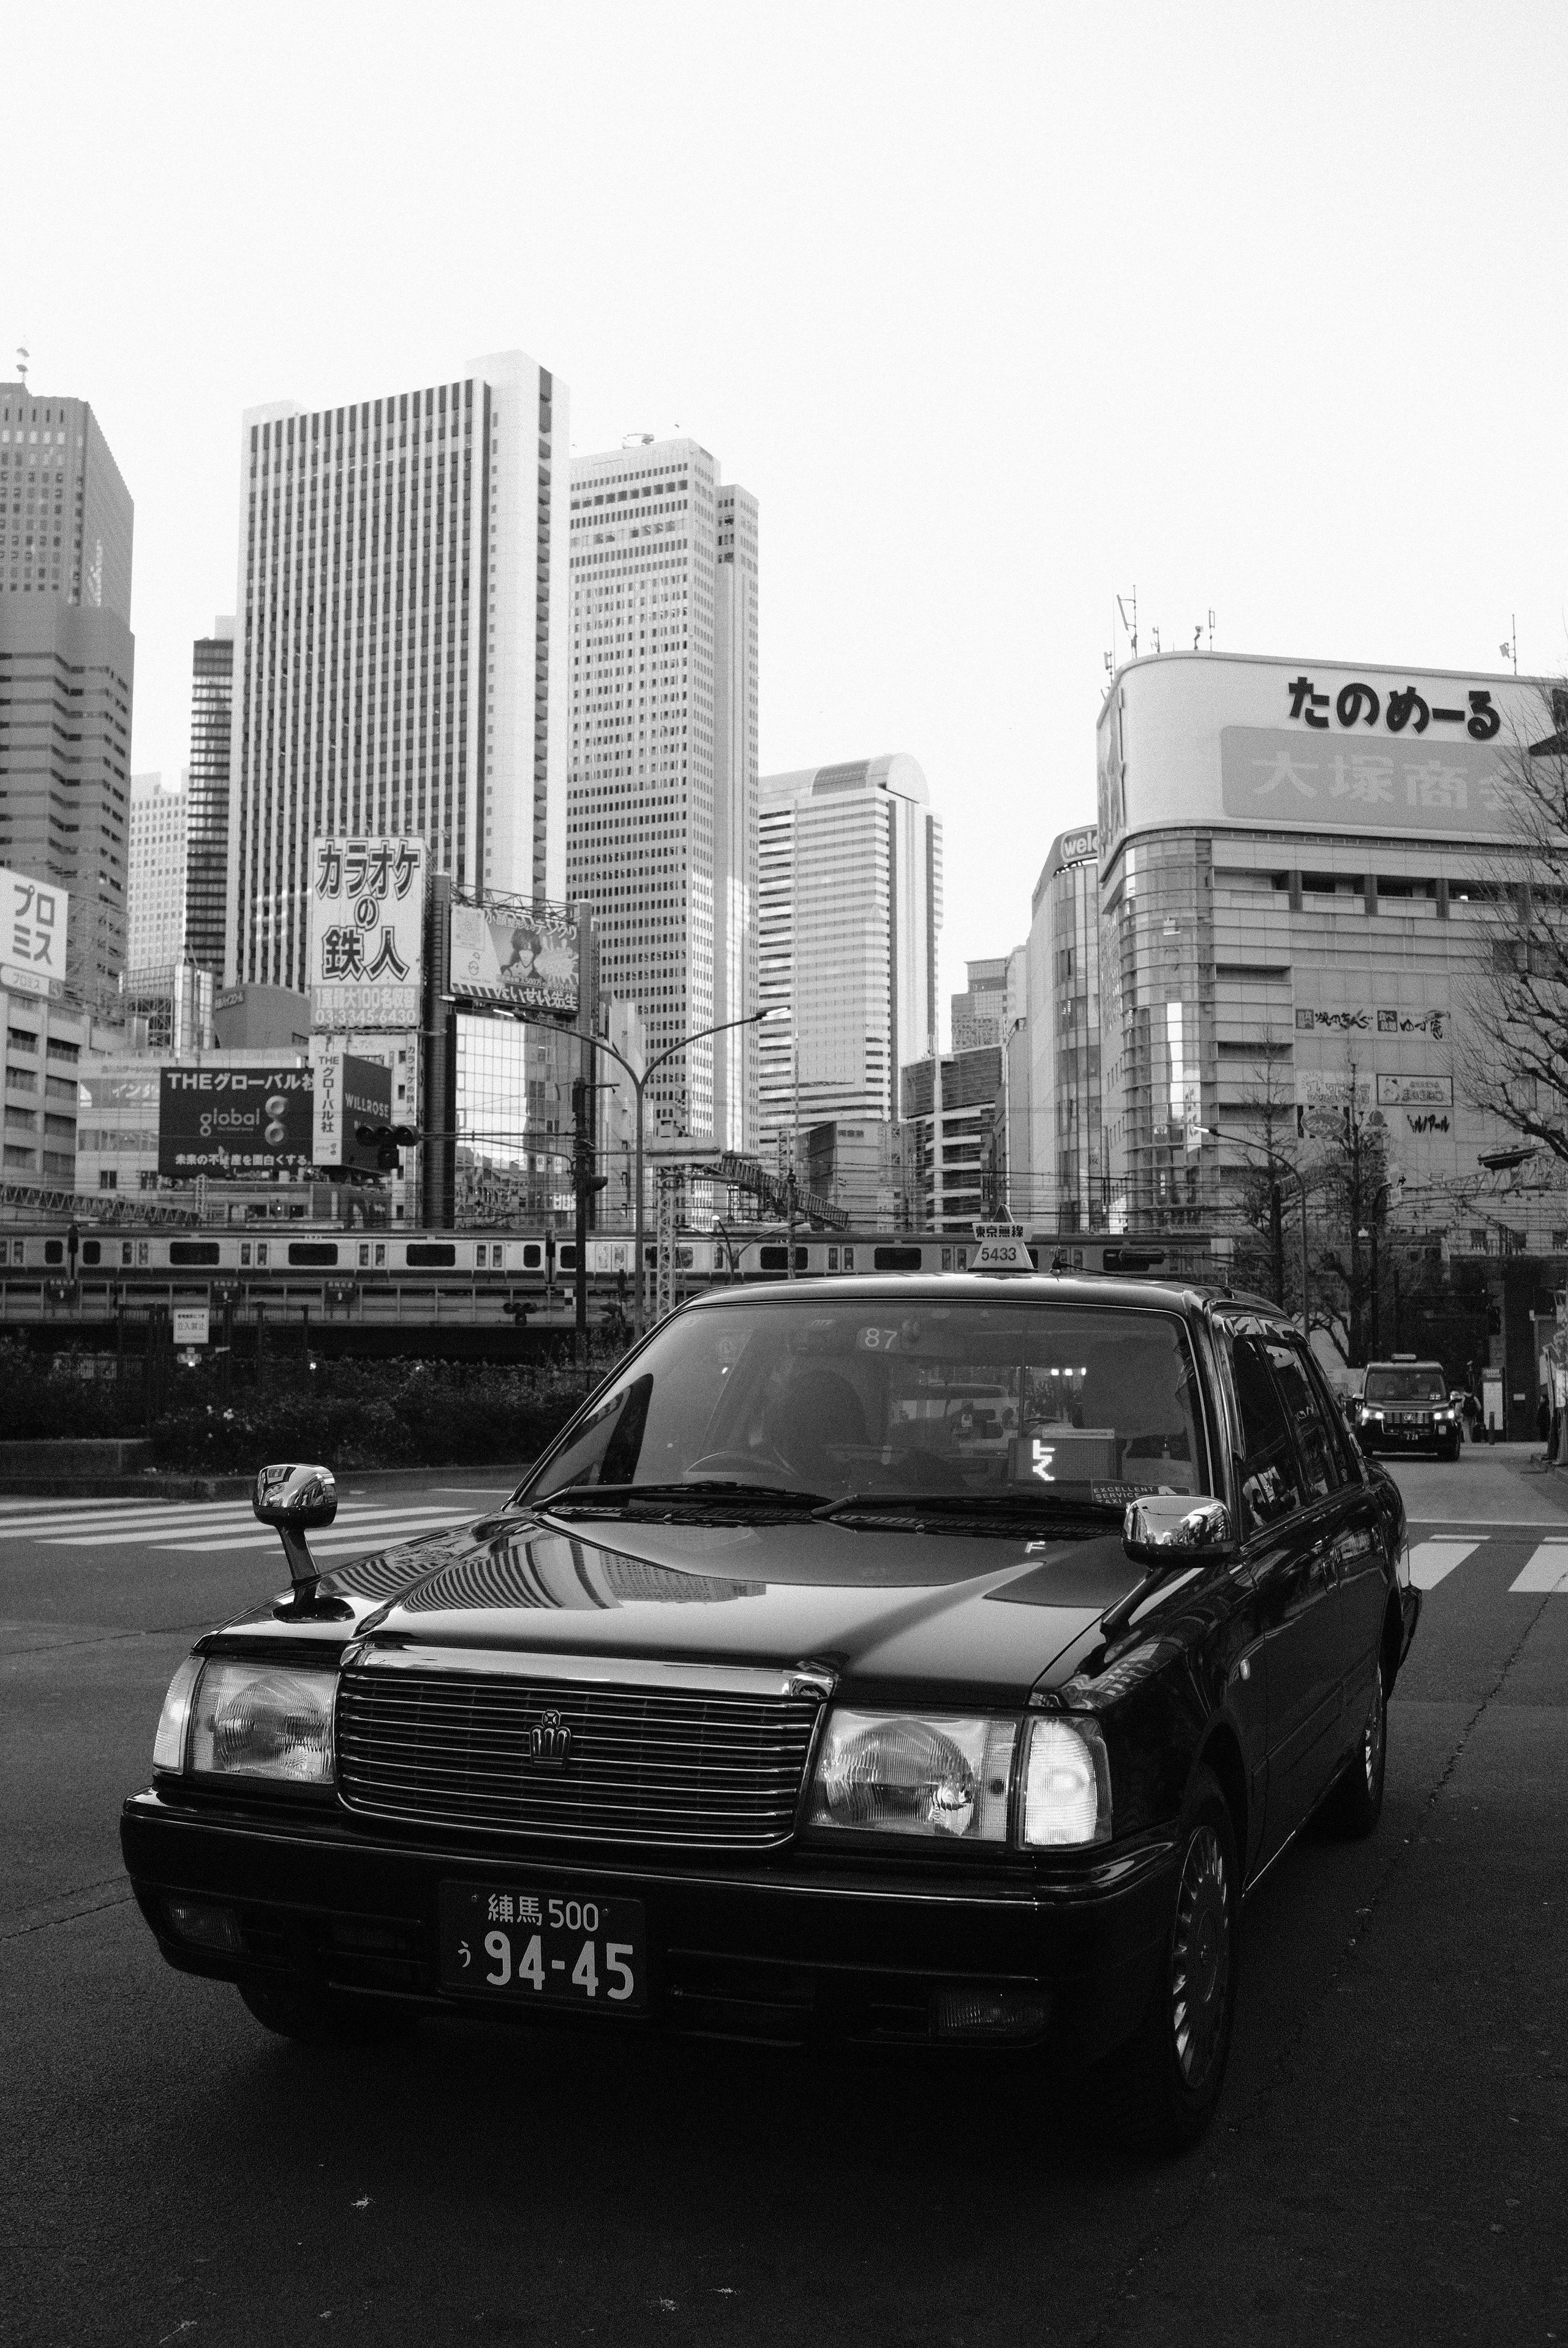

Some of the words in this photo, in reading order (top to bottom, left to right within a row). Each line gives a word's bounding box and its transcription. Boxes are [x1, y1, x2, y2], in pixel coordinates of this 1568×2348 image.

[1289, 676, 1501, 740] たのめーる
[316, 839, 420, 900] カラオケ
[14, 885, 55, 927] プロ
[354, 894, 379, 932] の
[12, 923, 52, 965] ミス
[322, 926, 410, 981] 鉄人
[406, 1046, 415, 1115] カラオケの鉄人
[200, 1108, 260, 1136] global
[345, 1092, 390, 1119] WILLROSE
[975, 1225, 1023, 1238] 東京無線
[981, 1247, 1017, 1261] 5433
[864, 1328, 898, 1350] 87
[488, 1893, 542, 1925] 練馬
[549, 1899, 599, 1931] 500
[458, 1941, 471, 1968] う
[484, 1931, 634, 2000] 94-45
